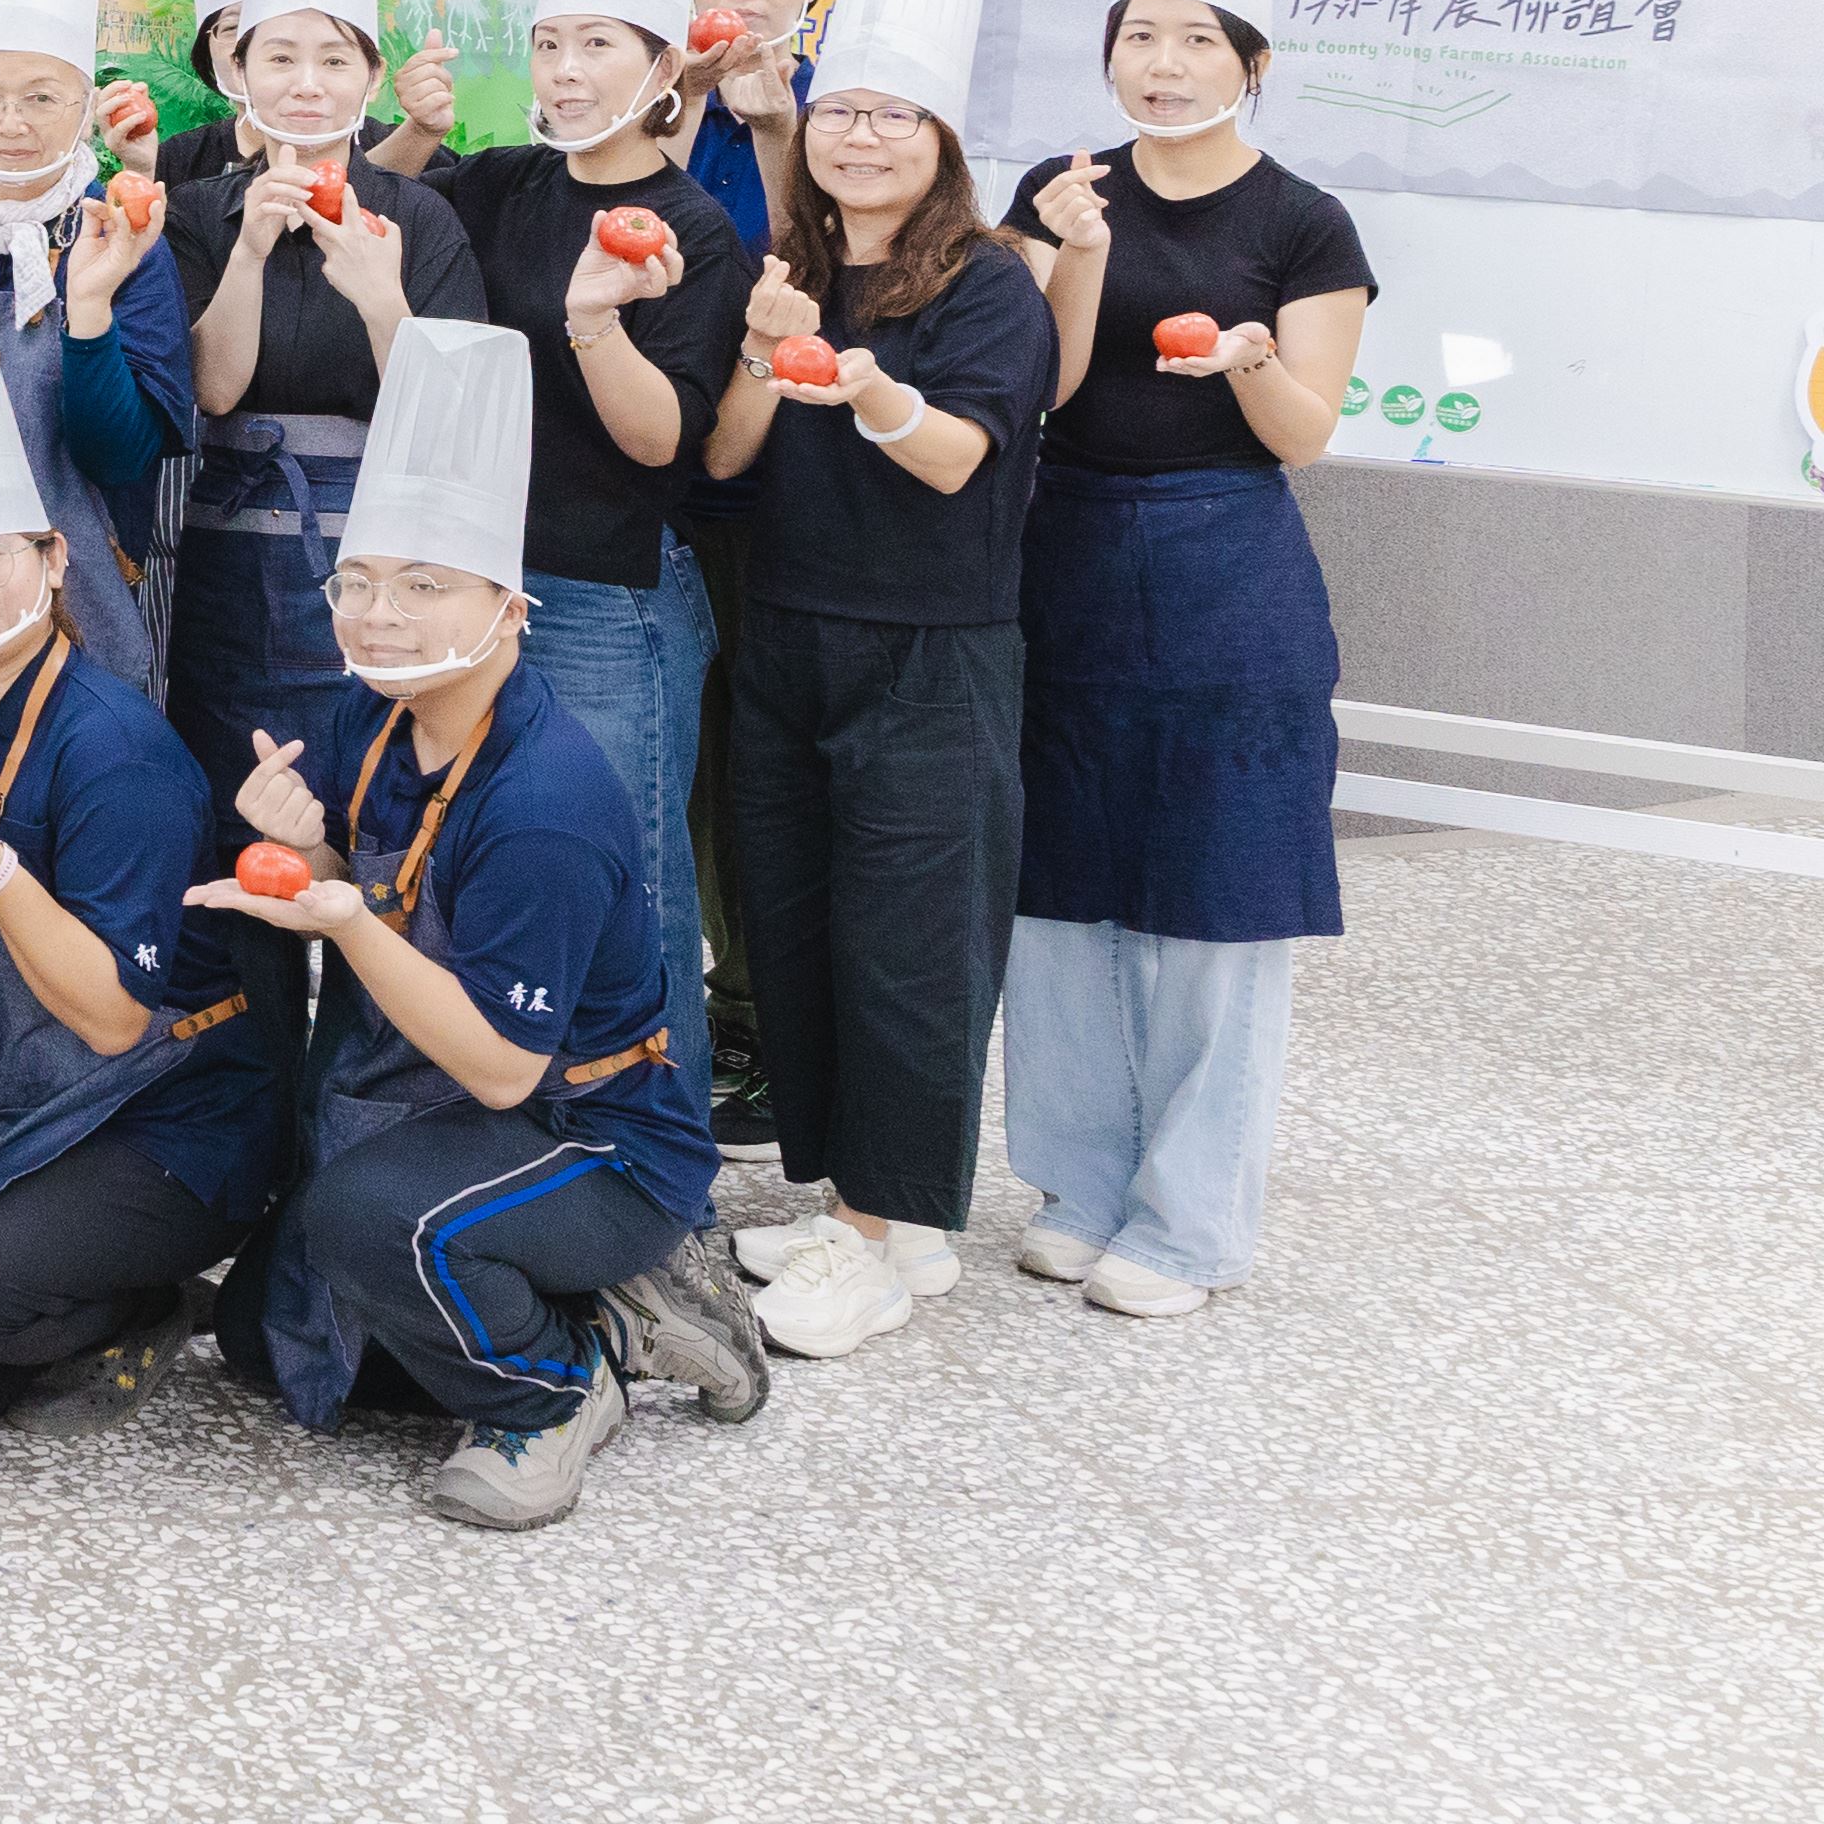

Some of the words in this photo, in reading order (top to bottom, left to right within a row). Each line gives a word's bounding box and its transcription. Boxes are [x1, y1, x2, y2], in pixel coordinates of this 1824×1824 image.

[1316, 39, 1378, 60] County
[1385, 41, 1431, 62] Young
[1440, 45, 1514, 64] Farmers
